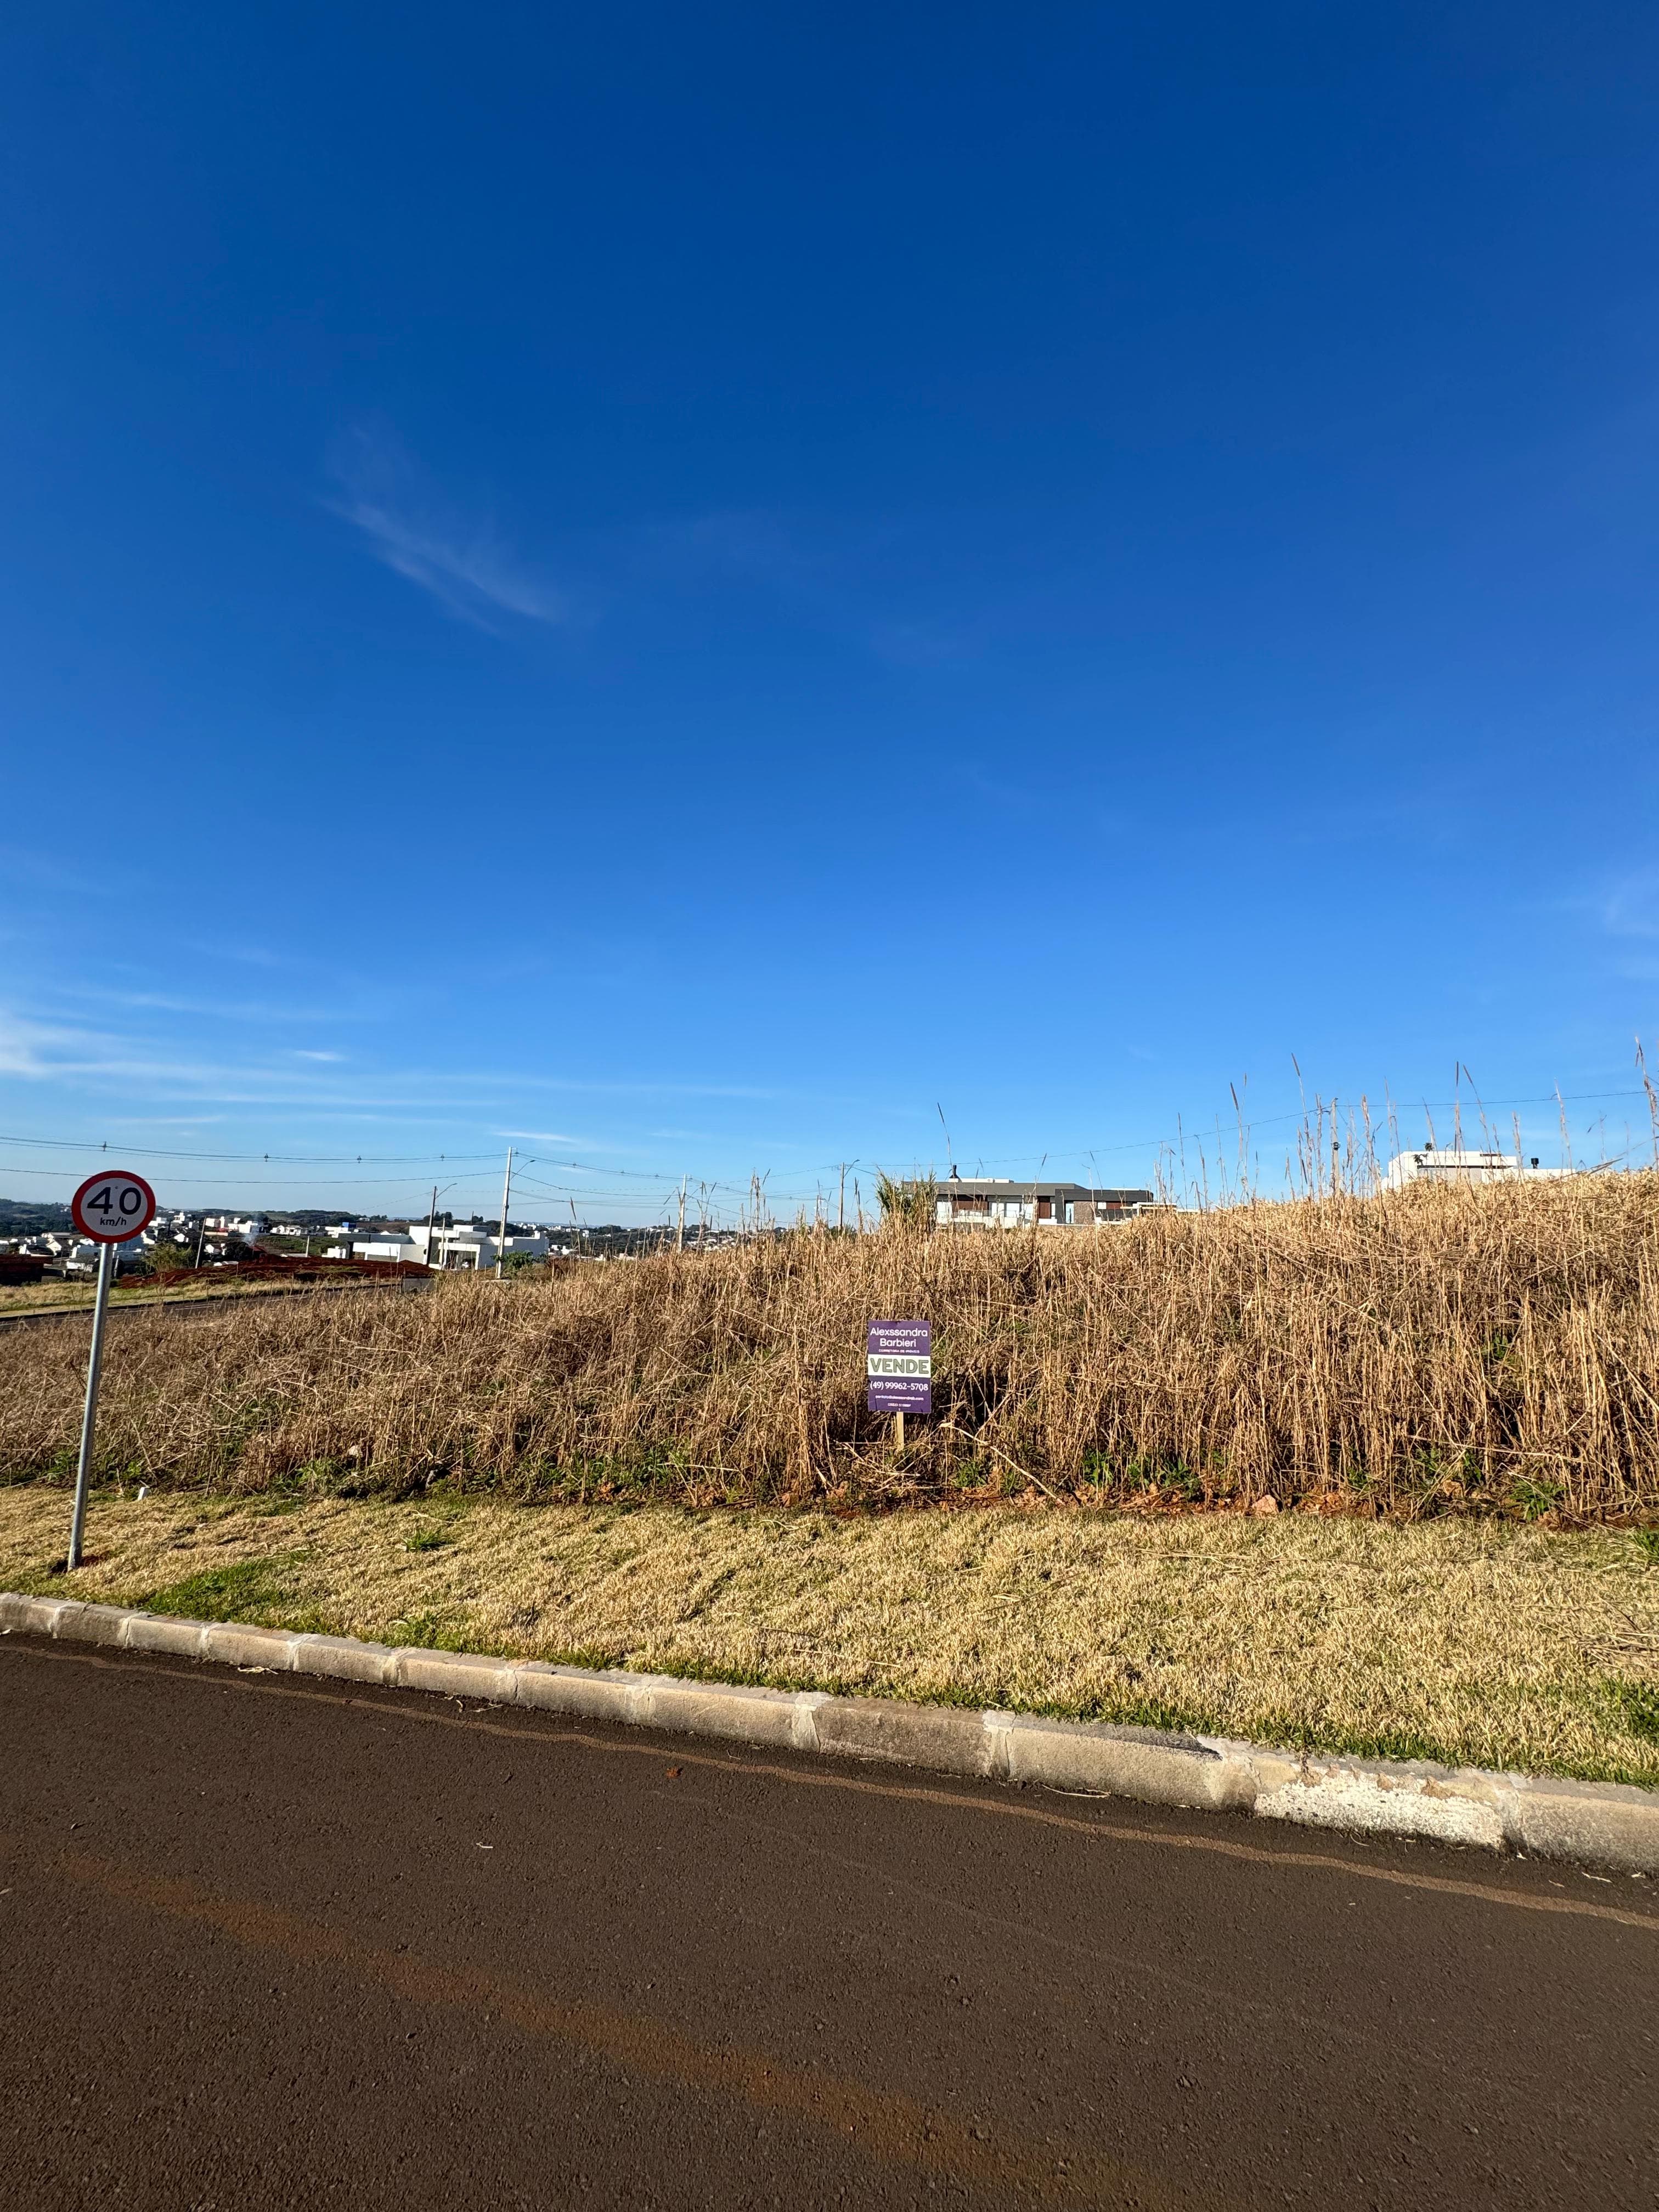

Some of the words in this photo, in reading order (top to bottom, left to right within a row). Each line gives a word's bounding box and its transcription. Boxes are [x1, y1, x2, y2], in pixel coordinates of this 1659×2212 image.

[87, 1187, 141, 1215] 40
[100, 1216, 126, 1226] km/h
[870, 1327, 928, 1336] Alexssandra
[880, 1338, 916, 1347] Barbieri
[870, 1358, 929, 1374] VENDE
[870, 1381, 883, 1390] (49)
[885, 1381, 928, 1391] 99962-5708
